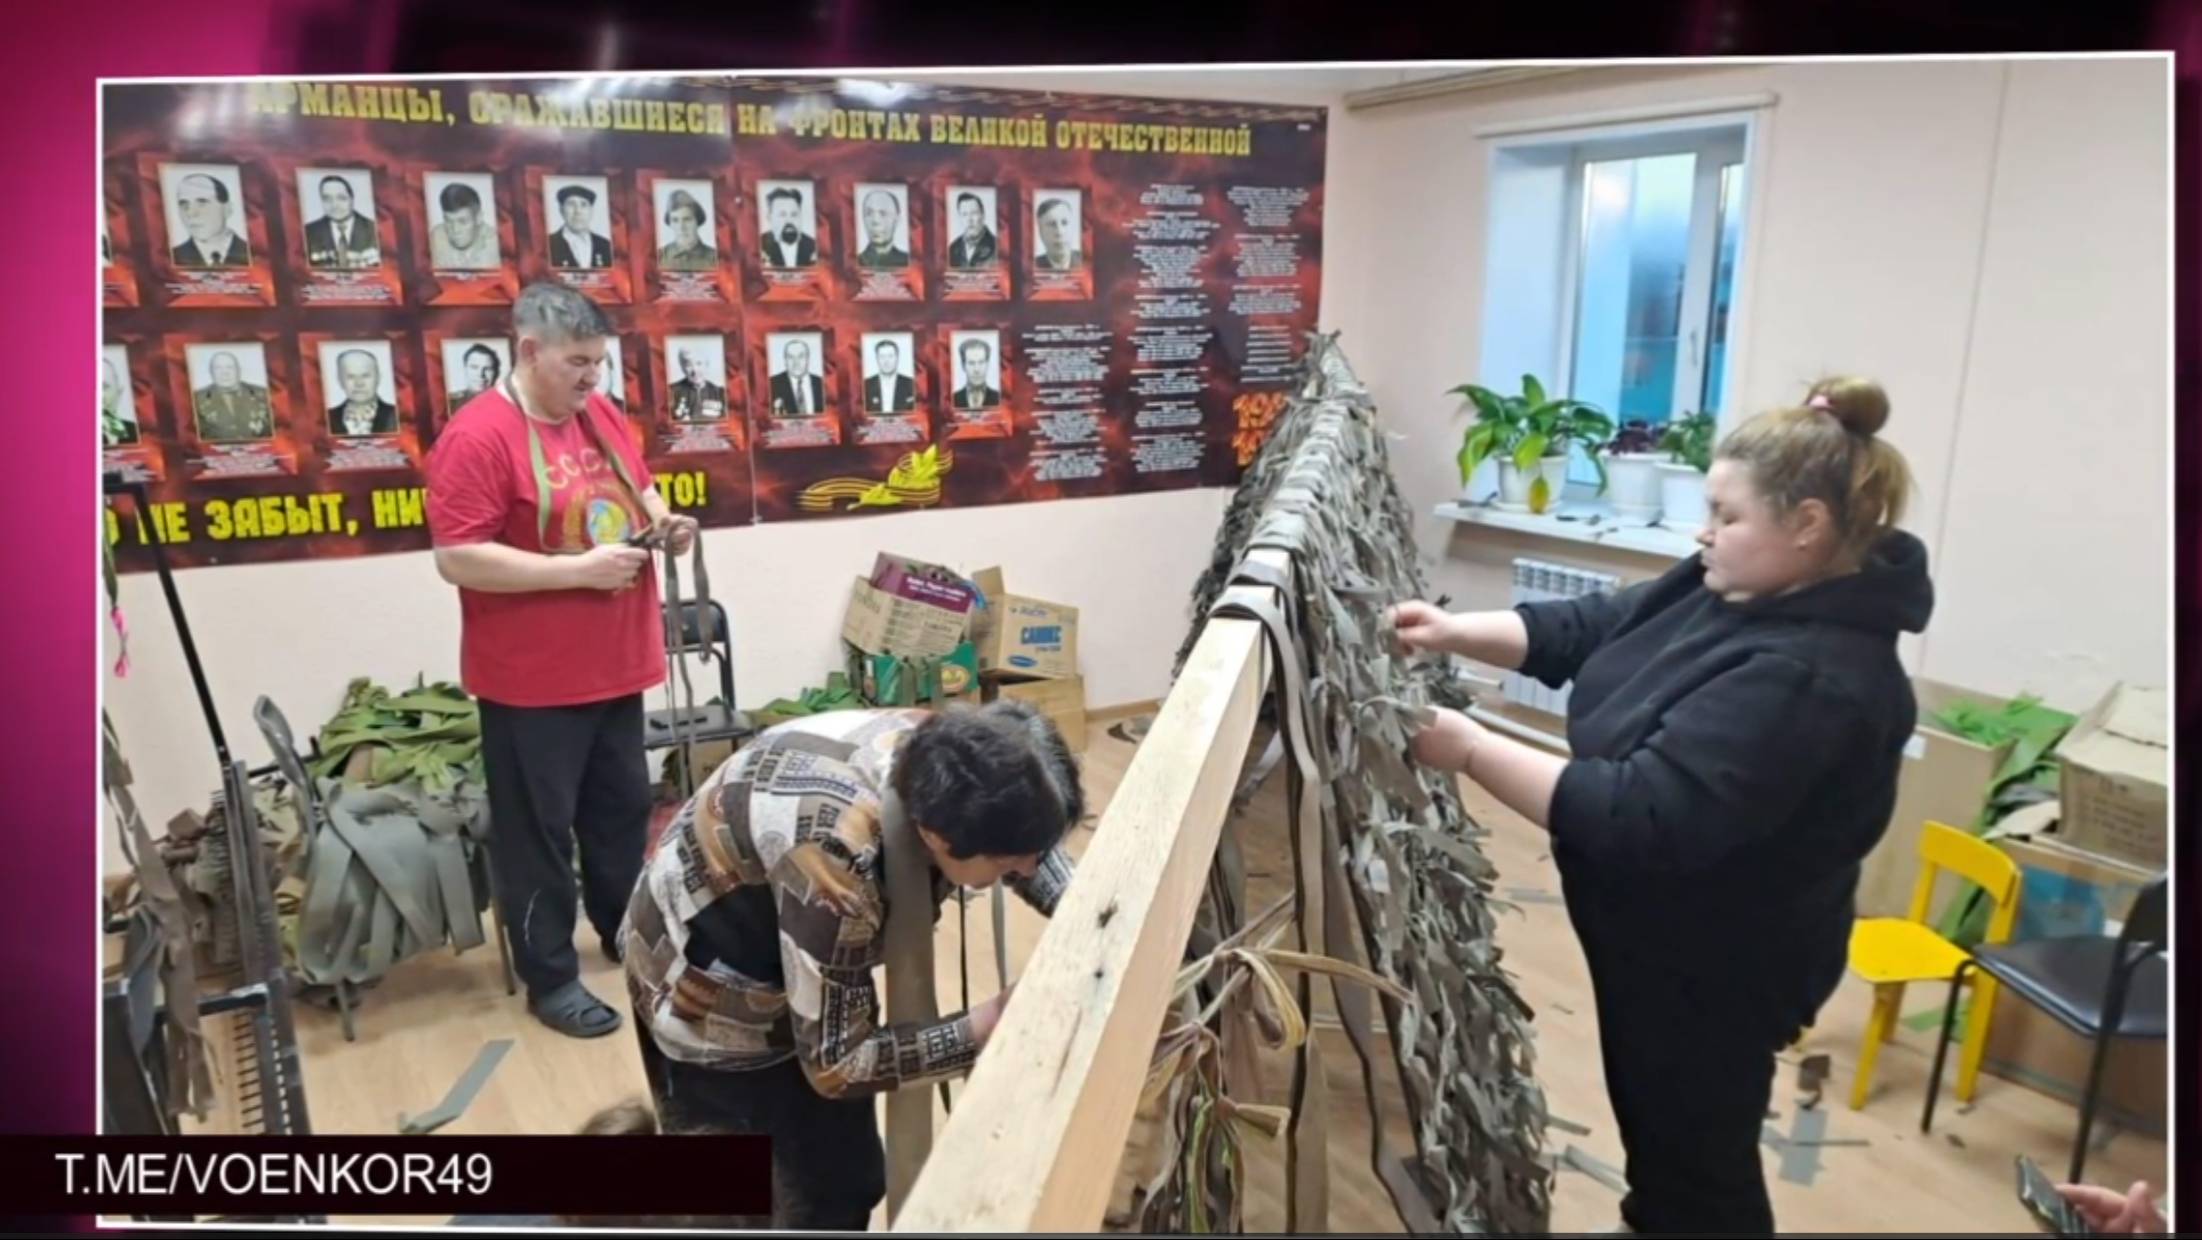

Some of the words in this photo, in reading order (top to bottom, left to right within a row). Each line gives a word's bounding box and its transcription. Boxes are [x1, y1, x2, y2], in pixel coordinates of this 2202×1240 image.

[469, 90, 726, 135] СРАЖАВШИЕСЯ
[738, 102, 777, 135] НА
[789, 102, 921, 143] ФРОНТАХ
[930, 113, 1048, 148] ВЕЛИКОЙ
[1056, 123, 1252, 156] ОТЕЧЕСТВЕННОЙ
[204, 493, 358, 540] ЗАБЫТ,
